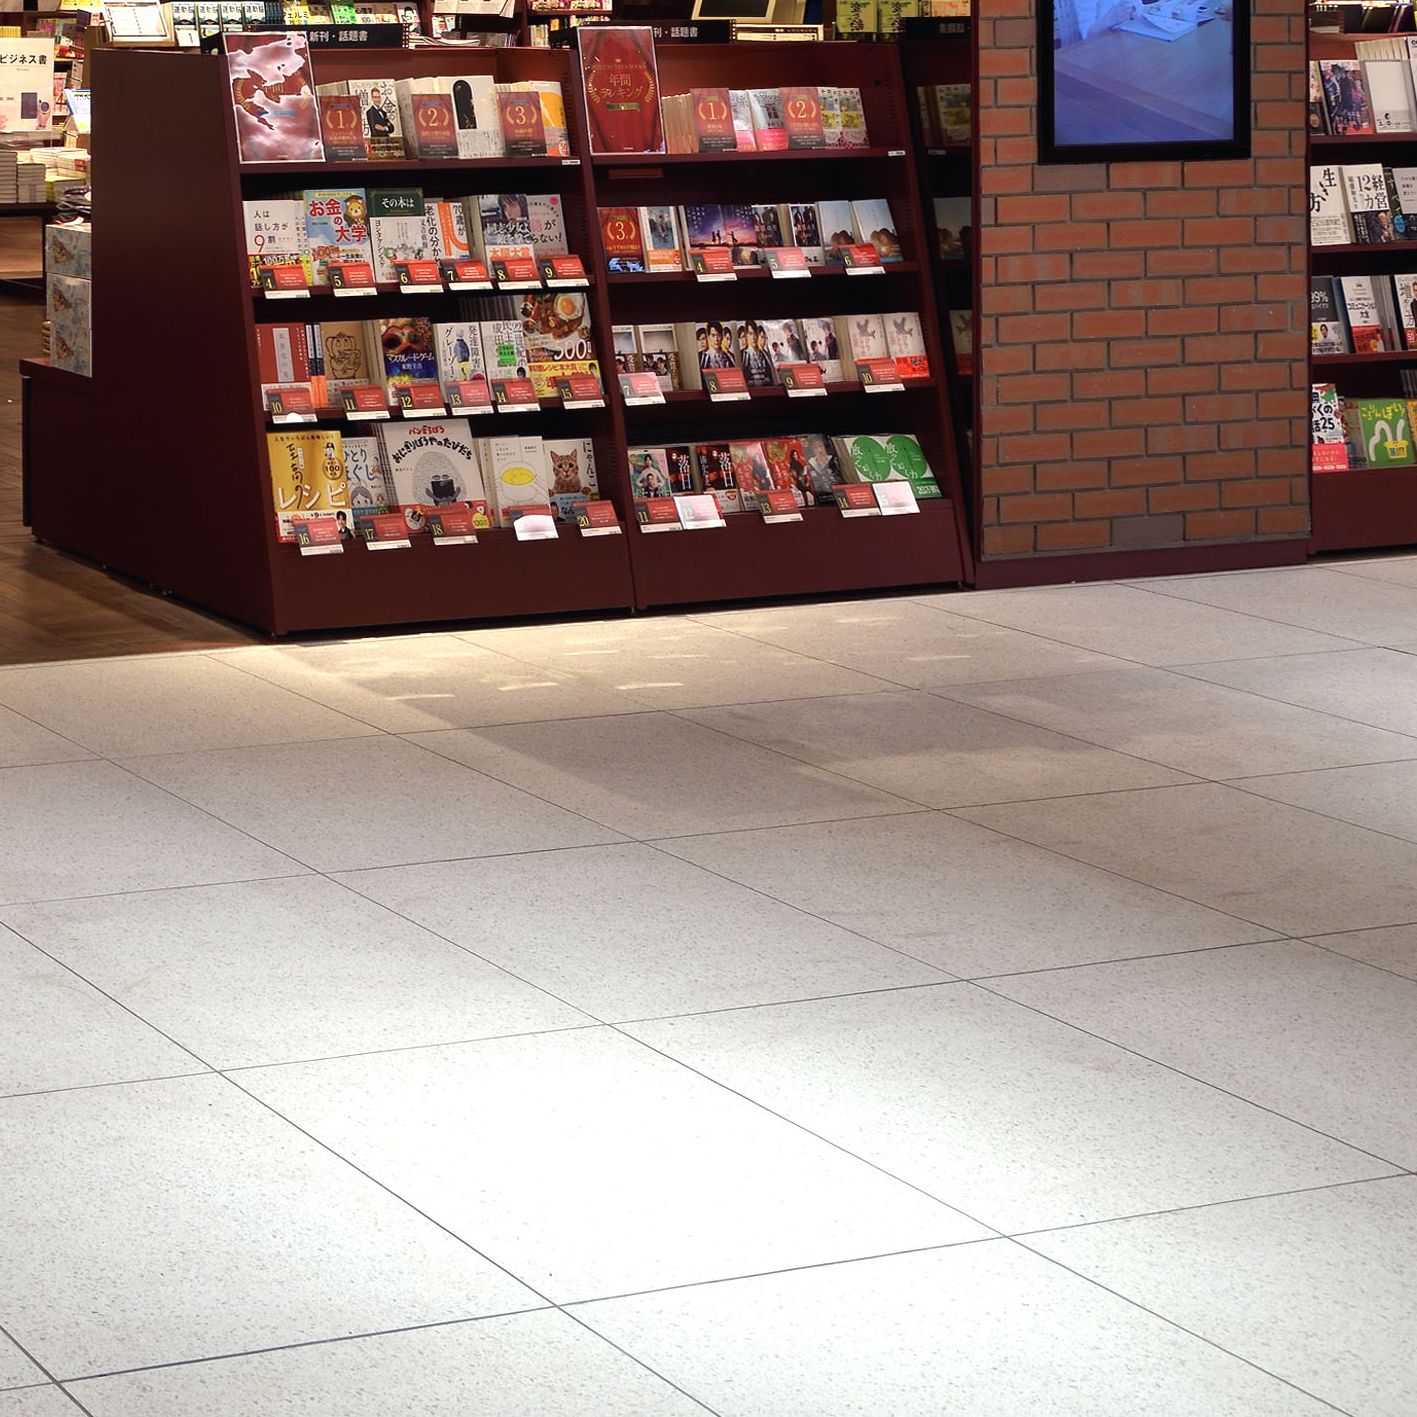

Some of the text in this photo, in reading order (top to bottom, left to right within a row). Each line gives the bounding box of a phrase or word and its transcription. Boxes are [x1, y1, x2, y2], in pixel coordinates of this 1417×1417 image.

[309, 30, 369, 43] 新刊・話題書
[609, 73, 631, 87] 年間
[600, 86, 644, 98] ランキング
[1371, 174, 1387, 209] 経営
[309, 198, 342, 217] お金
[381, 196, 415, 208] その本は
[254, 210, 270, 219] 人は
[453, 205, 466, 236] 70歳が
[254, 222, 289, 232] 話し方が
[333, 216, 343, 226] の
[334, 225, 367, 243] 大学
[696, 261, 703, 272] 4
[770, 259, 778, 269] 5
[844, 256, 852, 267] 6
[400, 272, 408, 283] 6
[447, 270, 454, 281] 7
[496, 269, 506, 280] 8
[545, 267, 553, 278] 9
[265, 277, 273, 289] 4
[333, 275, 342, 286] 5
[786, 377, 794, 388] 9
[862, 373, 873, 385] 10
[624, 385, 631, 397] 7
[708, 380, 717, 392] 8
[450, 393, 462, 405] 13
[495, 391, 507, 403] 14
[561, 388, 572, 399] 15
[272, 402, 283, 413] 10
[344, 399, 356, 411] 11
[400, 396, 413, 408] 12
[408, 425, 446, 435] パンどろぼう
[392, 436, 473, 464] おにぎりぼうやのたびだち
[582, 441, 597, 487] にゃんこ
[286, 442, 303, 510] 至高の
[278, 482, 346, 510] レシピ
[760, 502, 772, 514] 13
[838, 497, 849, 509] 14
[577, 515, 590, 527] 20
[637, 511, 649, 523] 11
[365, 528, 374, 540] 17
[431, 523, 443, 535] 18
[299, 533, 310, 545] 16
